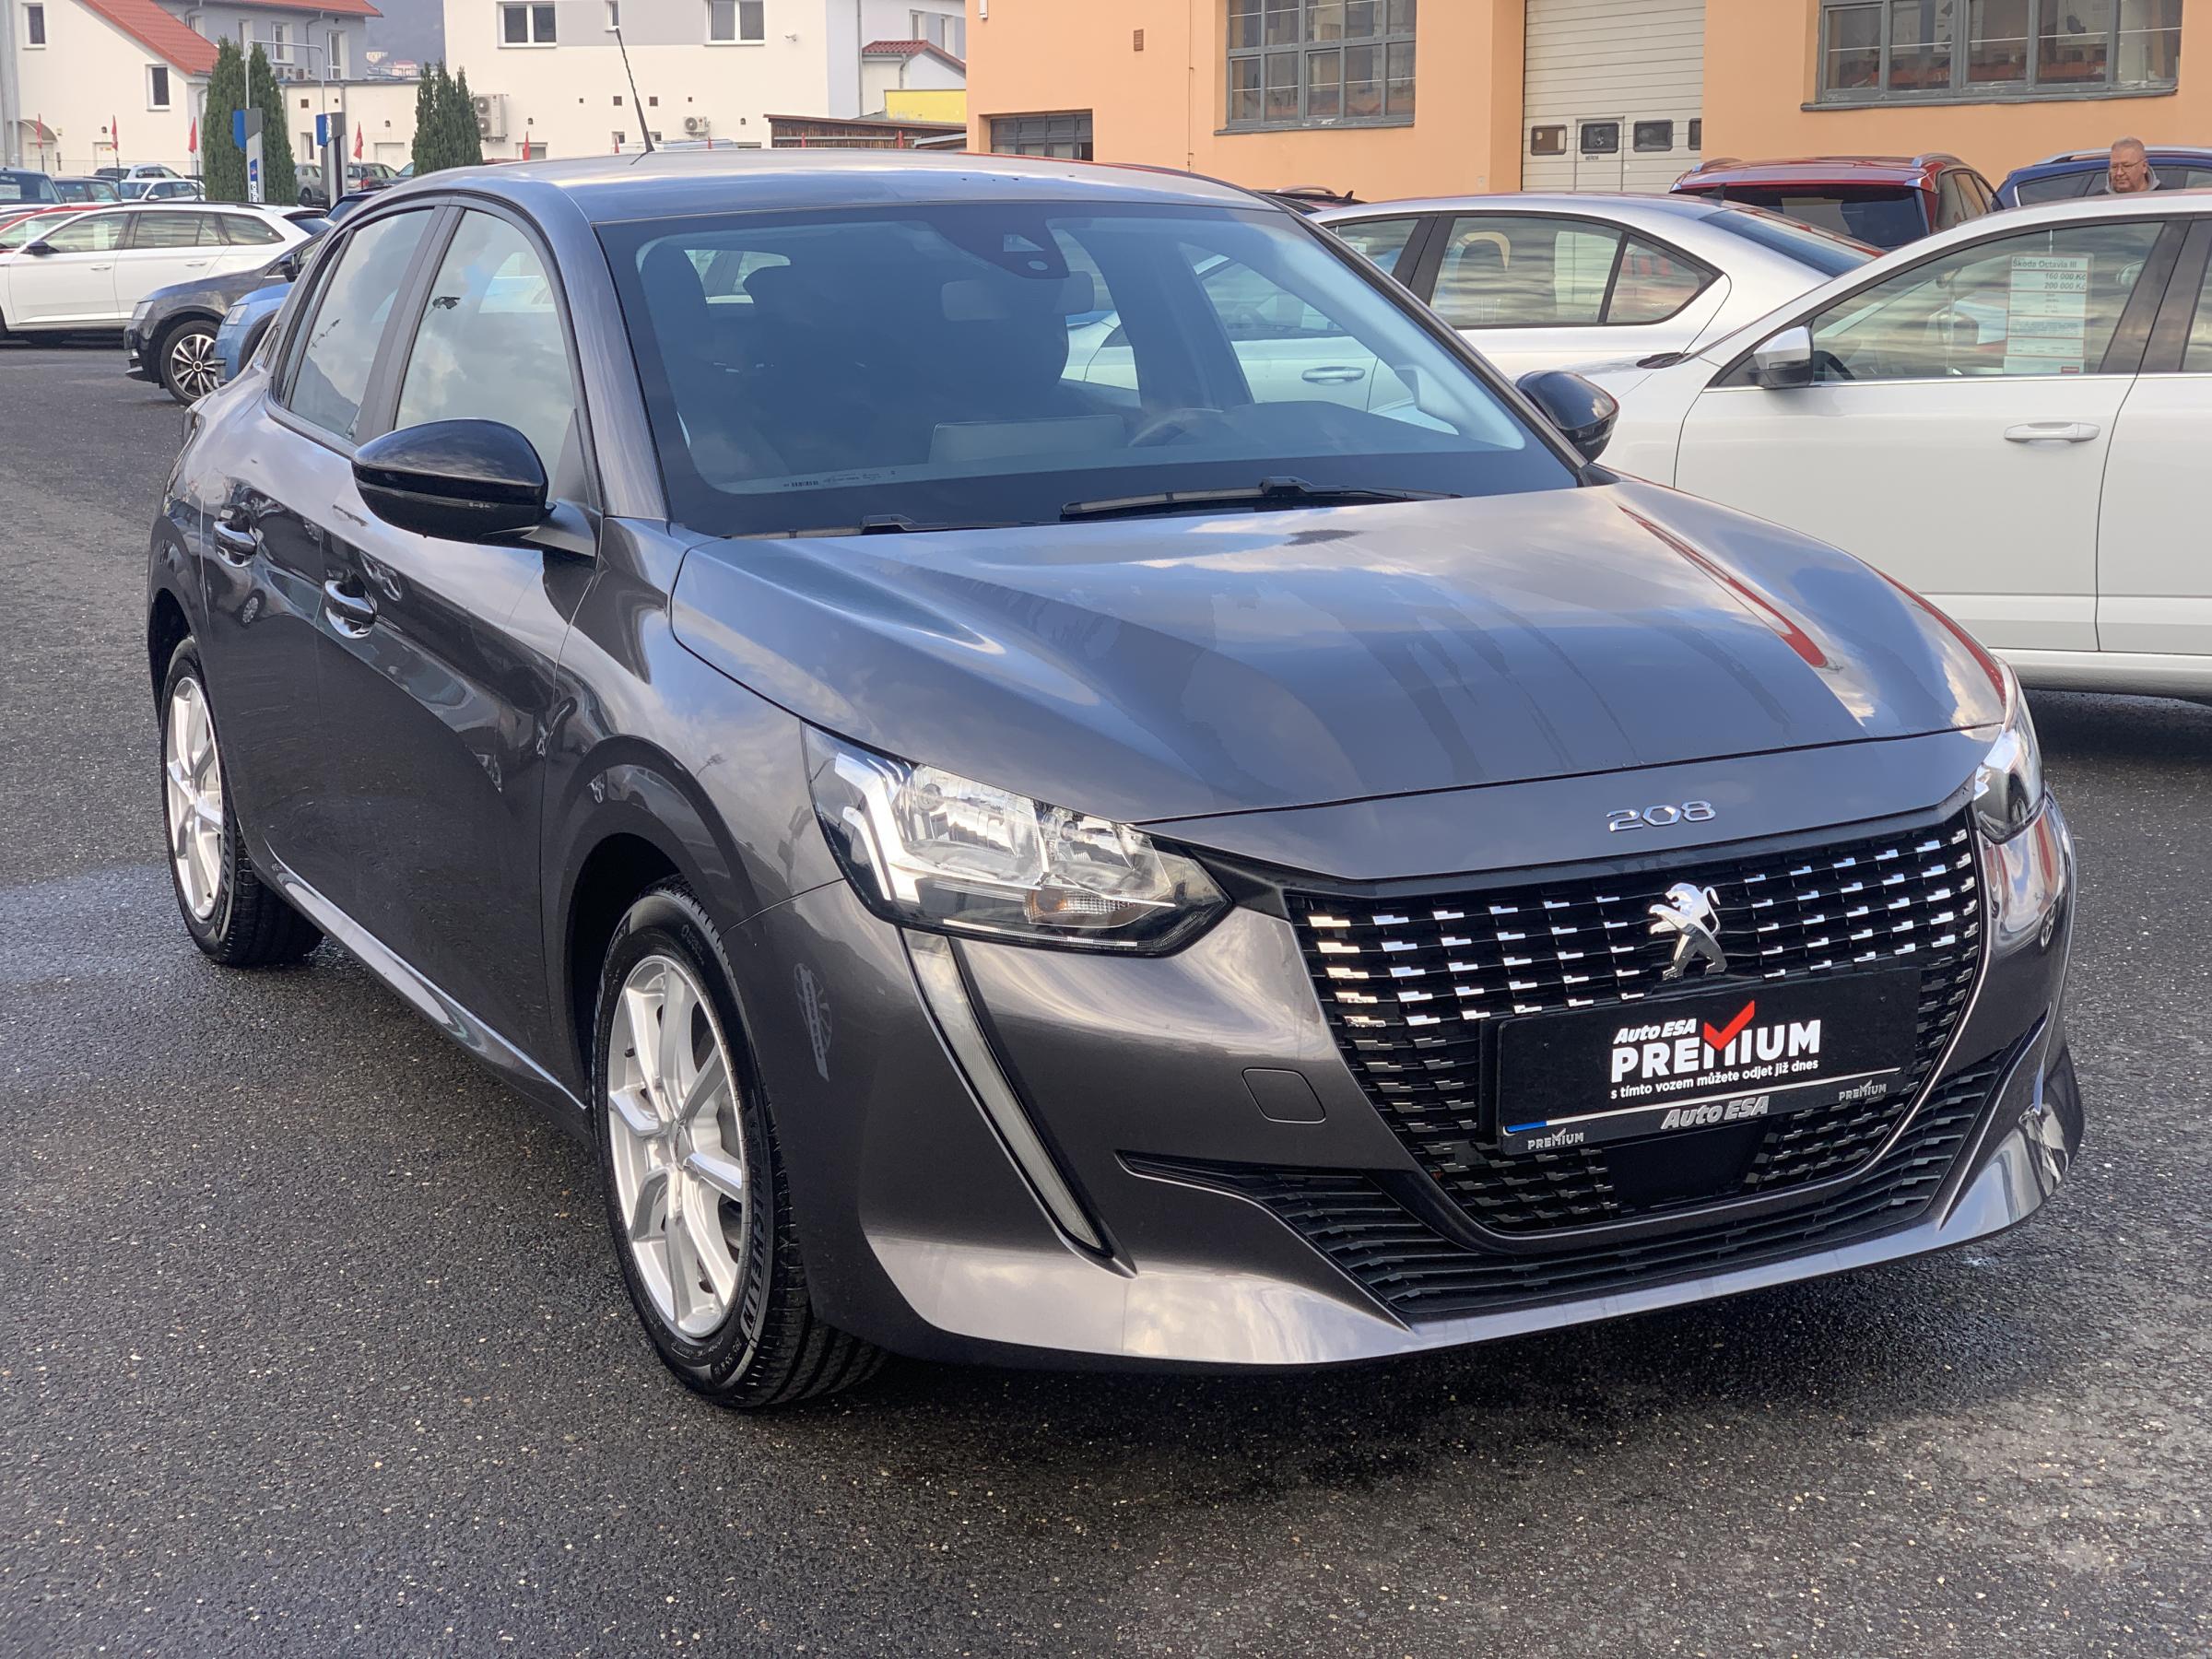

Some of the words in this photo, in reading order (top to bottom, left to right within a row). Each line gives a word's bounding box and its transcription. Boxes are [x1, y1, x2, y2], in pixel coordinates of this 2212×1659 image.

[1606, 800, 1716, 831] 208
[1614, 1025, 1660, 1045] Auto
[1661, 1018, 1698, 1039] ESA
[1611, 1019, 1821, 1084] PREMIUM
[1610, 1089, 1618, 1100] s
[1620, 1083, 1653, 1098] tímto
[1655, 1078, 1694, 1093] vozem
[1697, 1070, 1739, 1088] můžete
[1742, 1065, 1772, 1081] odjet
[1774, 1060, 1789, 1077] již
[1793, 1059, 1819, 1073] dnes
[1839, 1081, 1887, 1101] PREMIUM
[1660, 1104, 1724, 1130] Auto
[1724, 1095, 1770, 1122] ESA
[1527, 1130, 1584, 1150] PREMIUM
[743, 1164, 764, 1331] MICHELIN
